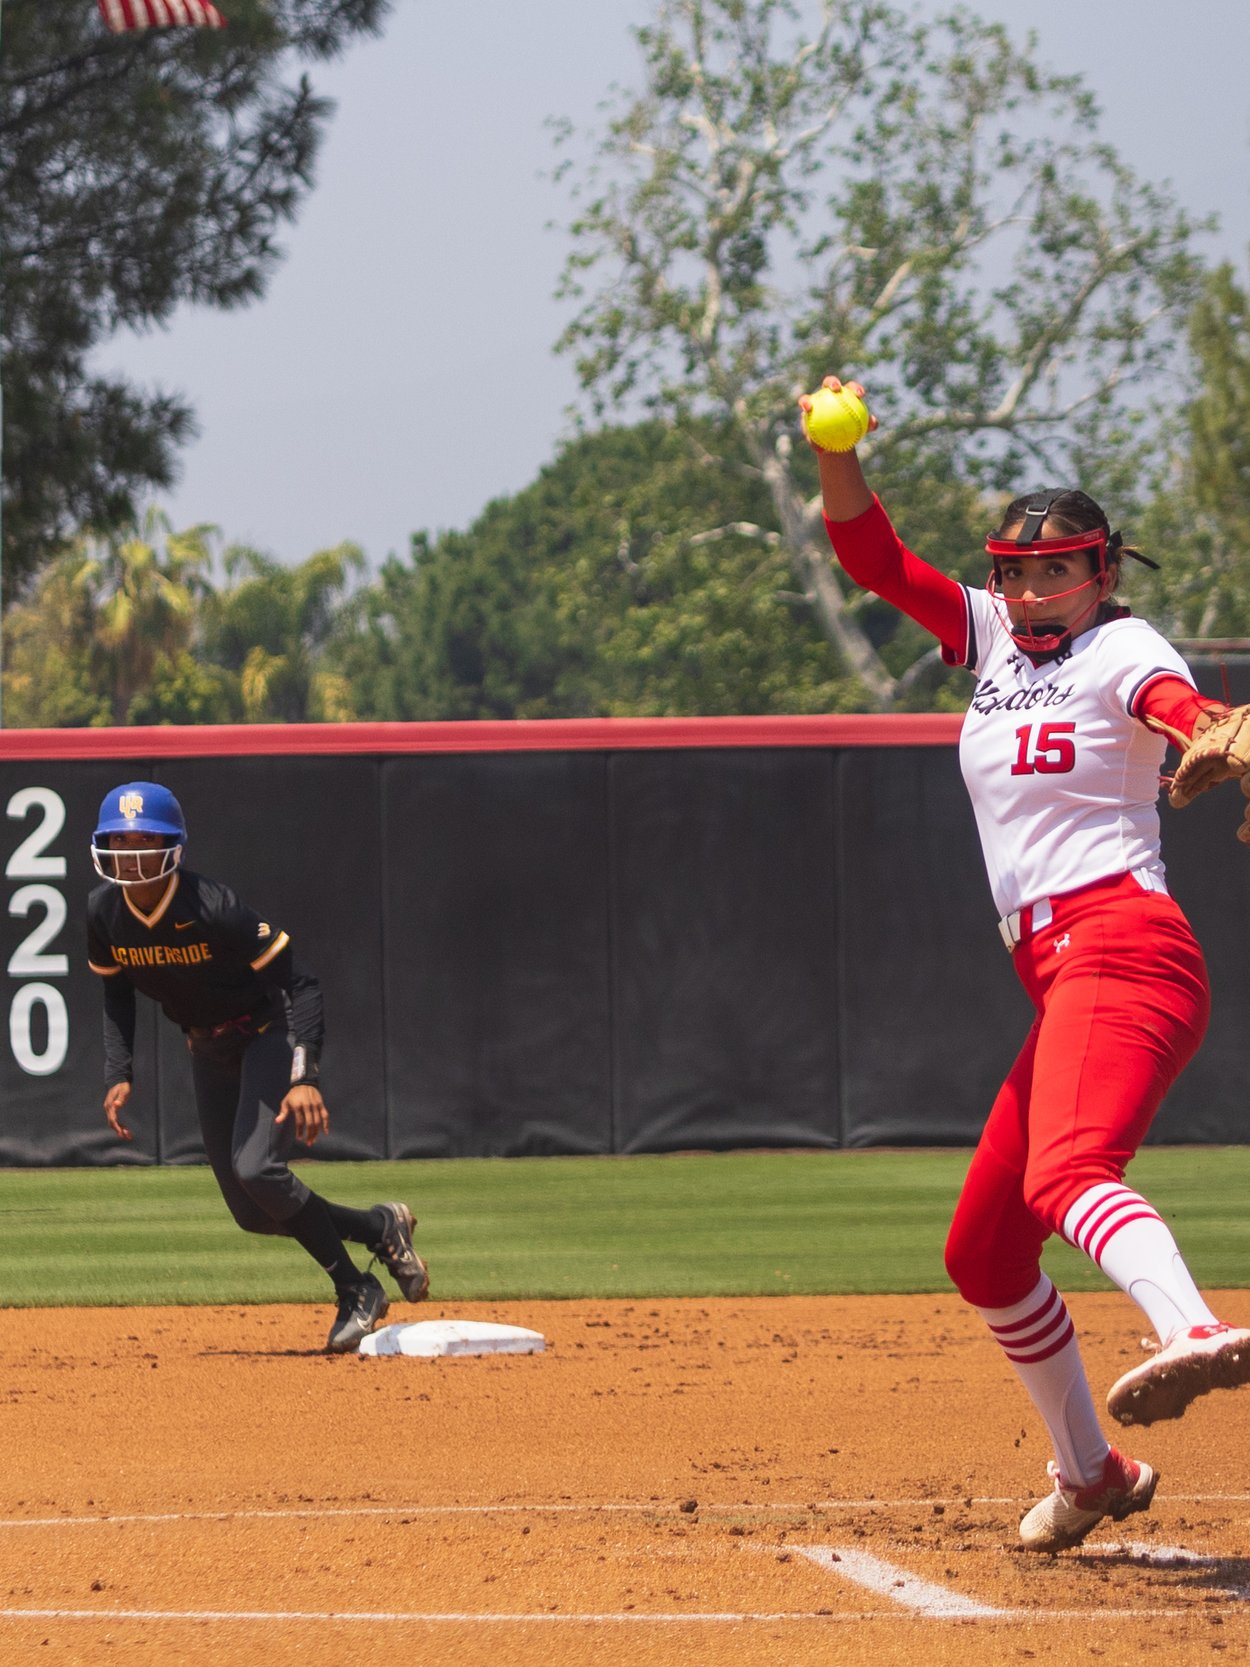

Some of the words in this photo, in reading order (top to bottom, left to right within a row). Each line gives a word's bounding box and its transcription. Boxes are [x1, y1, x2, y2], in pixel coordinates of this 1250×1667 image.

[1011, 722, 1077, 776] 15
[5, 786, 69, 1076] 220
[128, 943, 212, 966] RIVERSIDE
